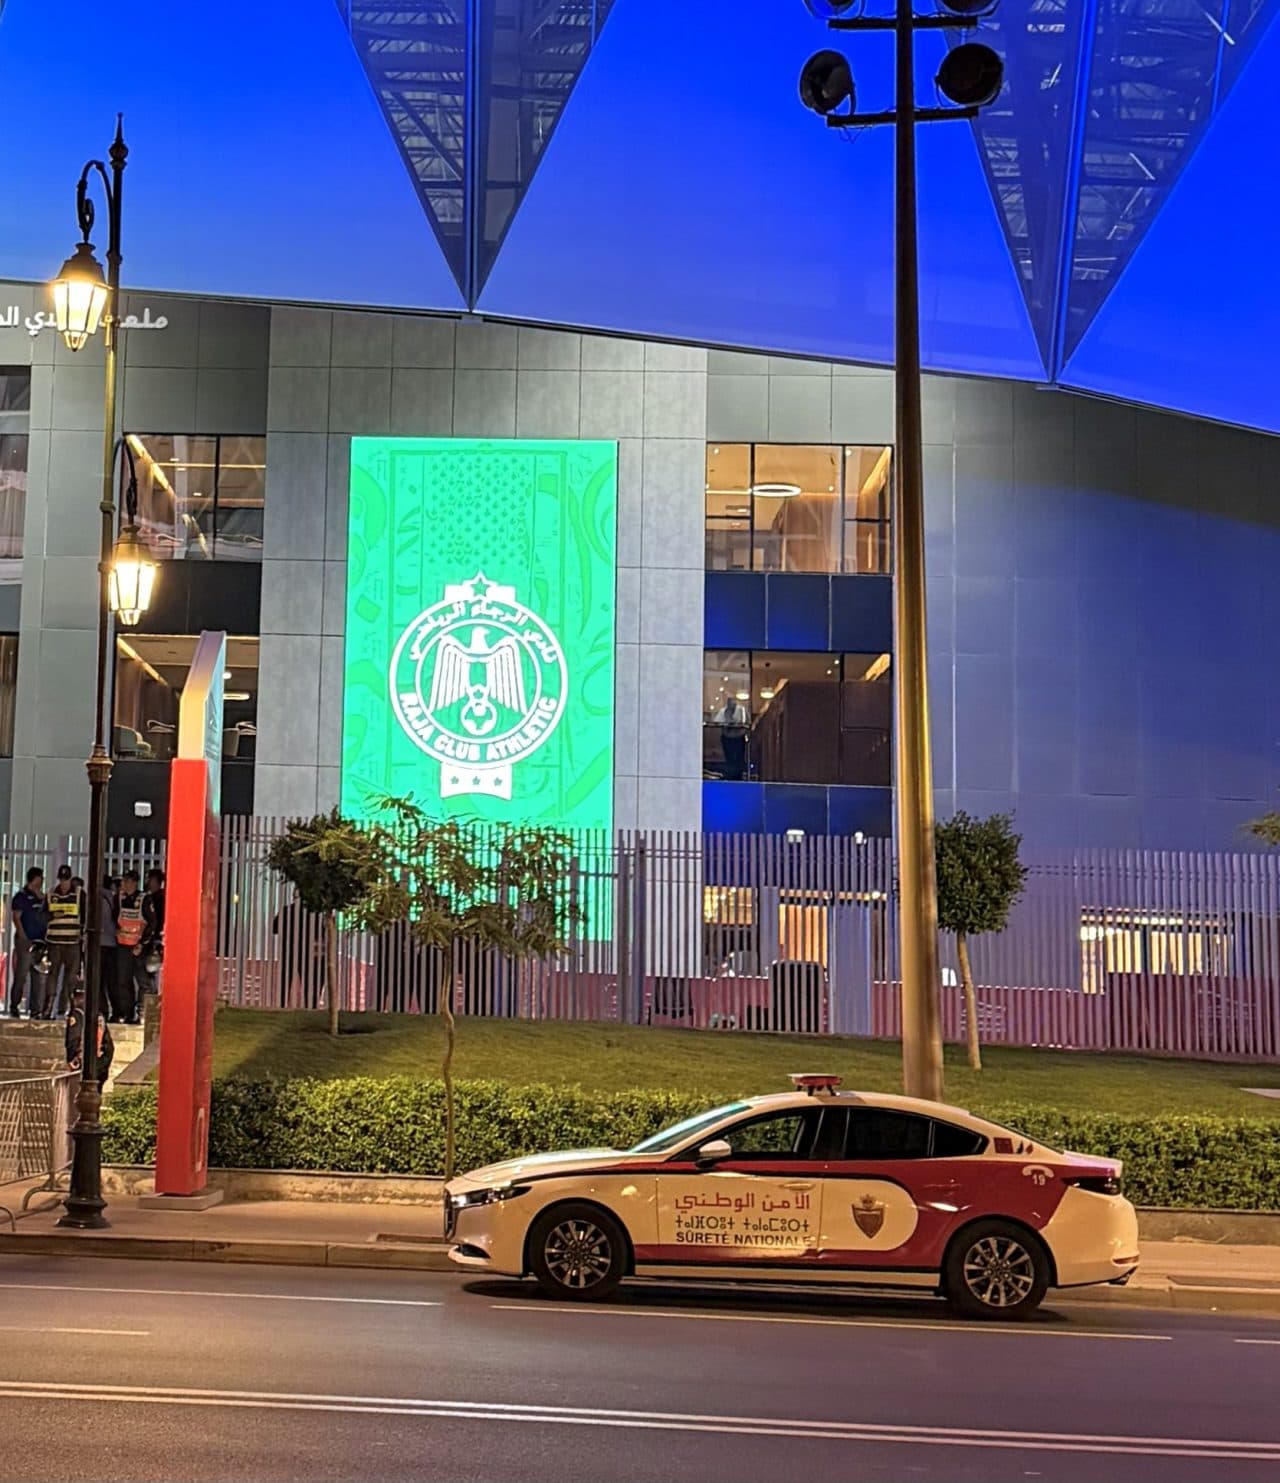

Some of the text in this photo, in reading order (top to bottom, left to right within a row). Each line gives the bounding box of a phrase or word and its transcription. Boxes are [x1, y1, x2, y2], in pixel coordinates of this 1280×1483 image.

[399, 692, 435, 742] RAJA
[433, 734, 480, 761] CLUB
[1032, 1173, 1046, 1186] 19
[675, 1191, 755, 1214] الوطني
[676, 1231, 812, 1247] SÛRETÉ NATIONALE
